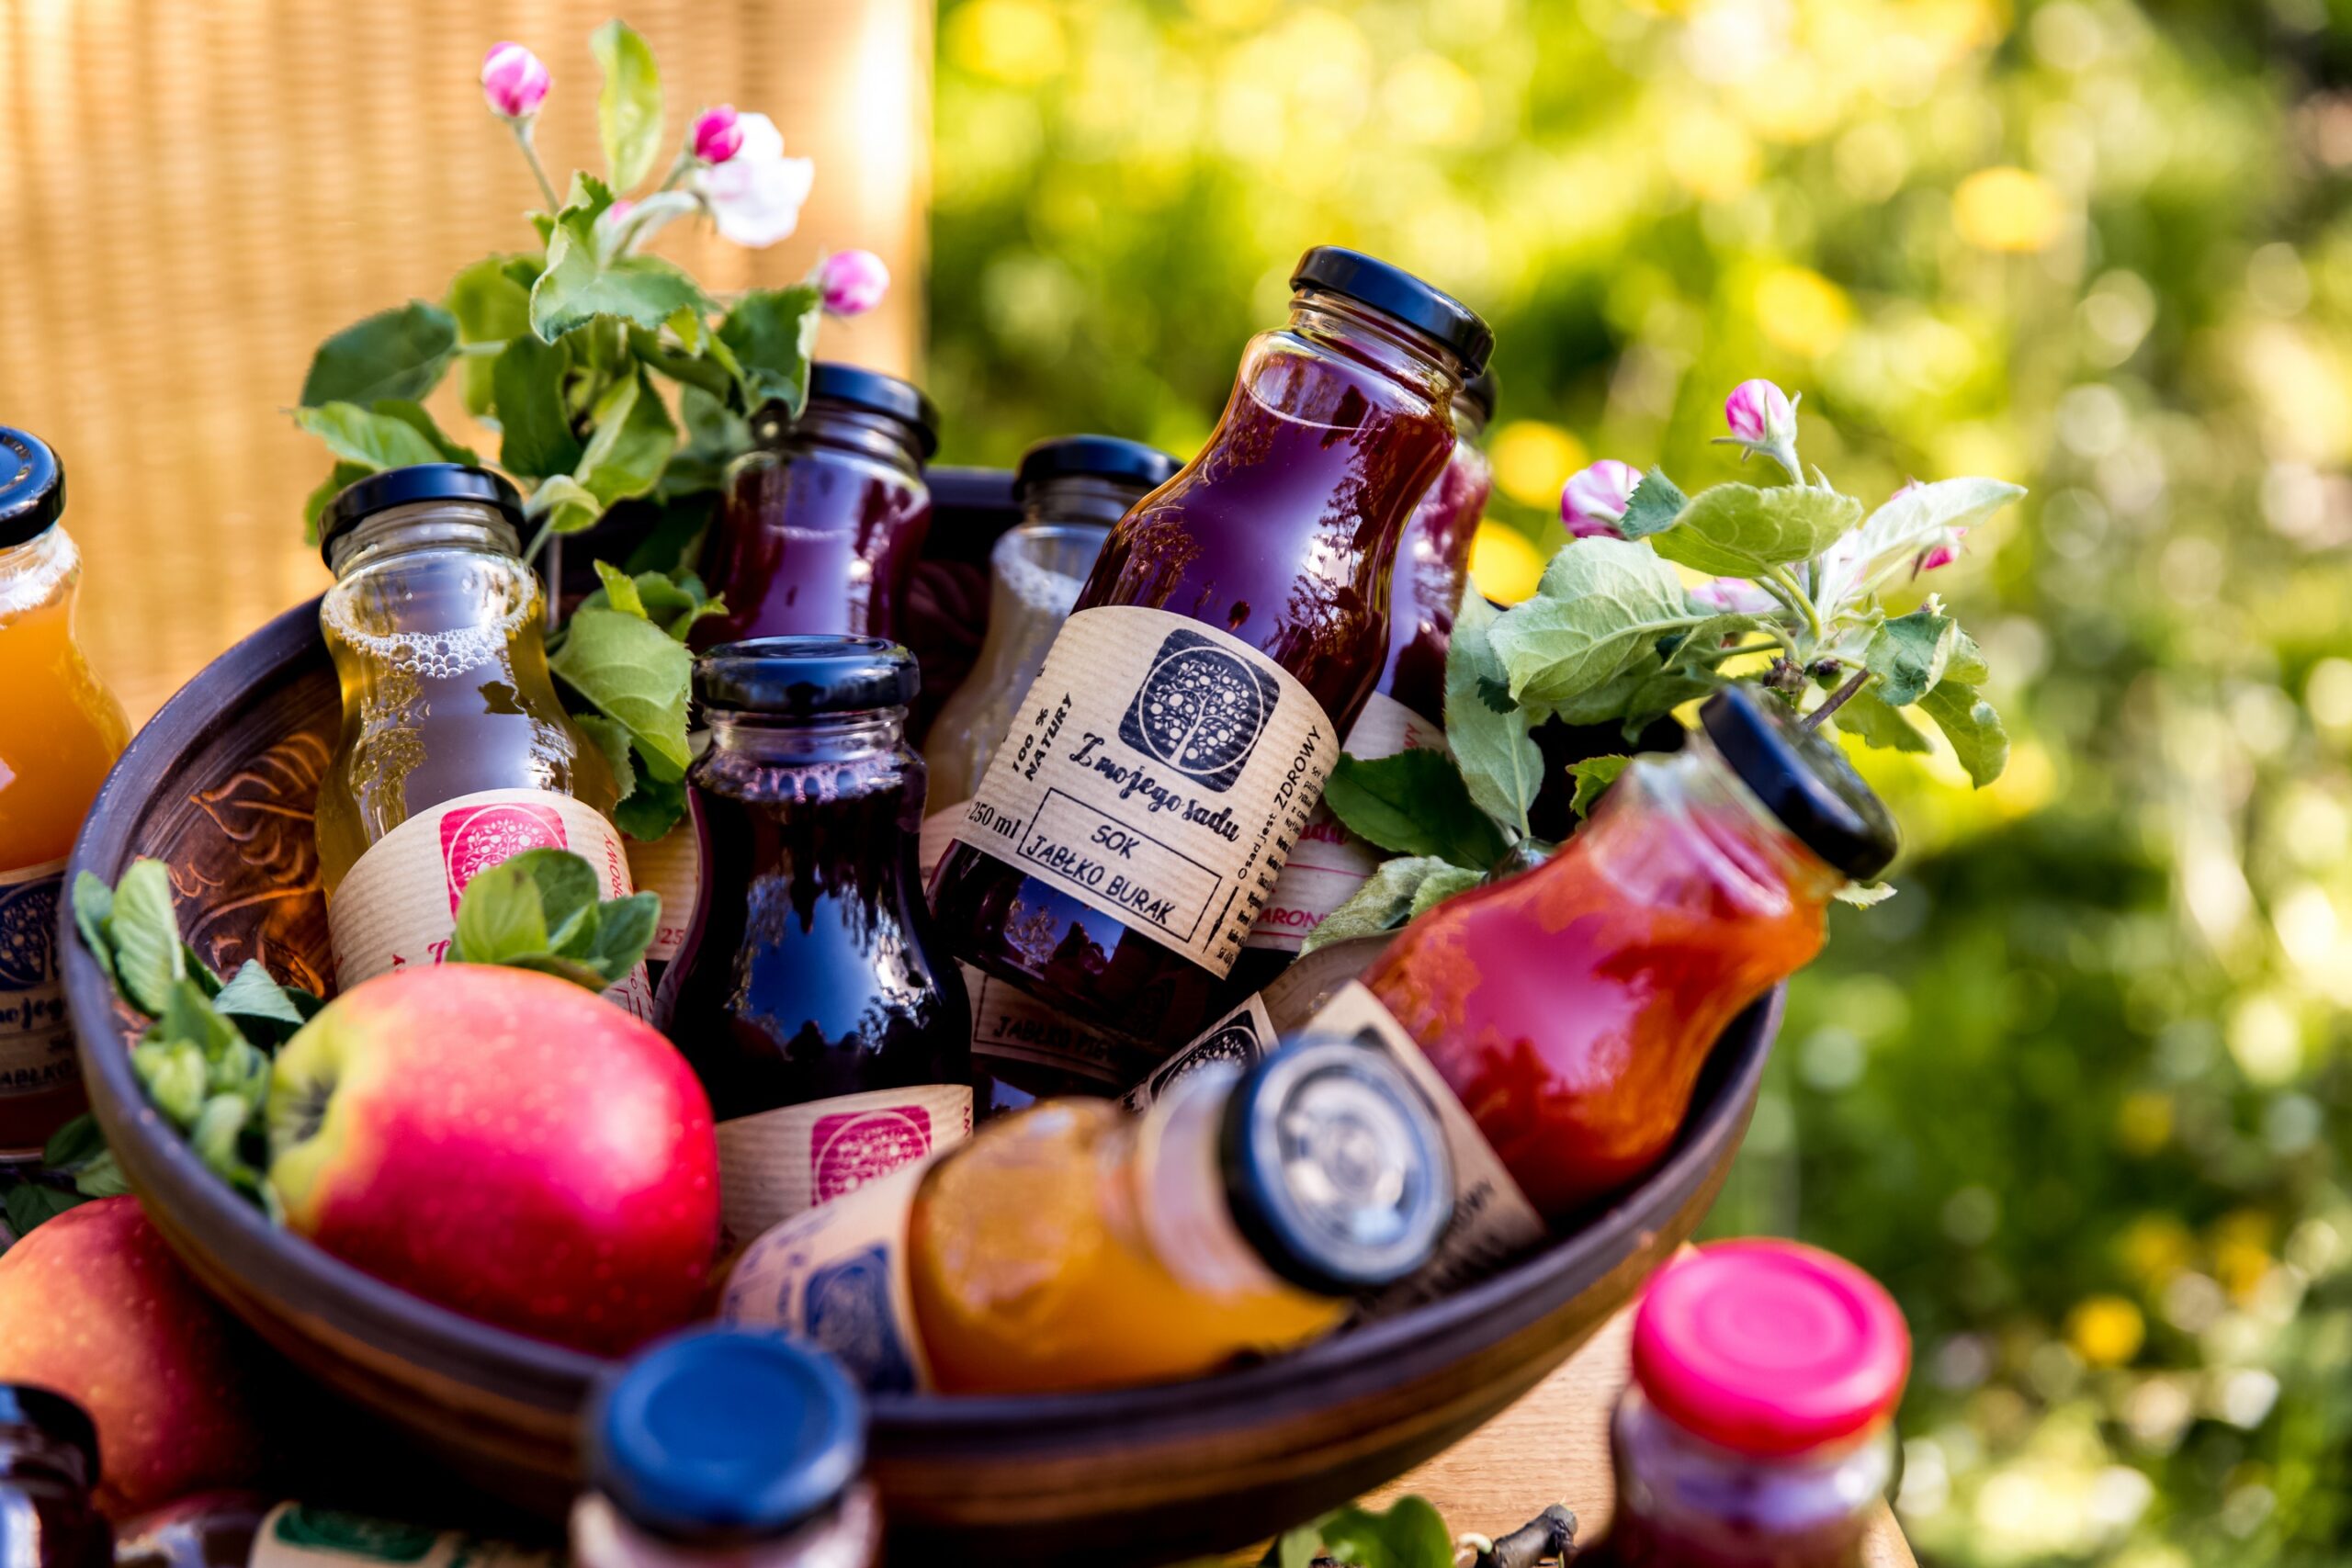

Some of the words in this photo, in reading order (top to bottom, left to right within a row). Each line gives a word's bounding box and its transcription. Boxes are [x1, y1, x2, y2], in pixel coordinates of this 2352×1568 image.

[1012, 734, 1035, 773] 100
[1035, 707, 1049, 727] %
[1023, 692, 1073, 782] NATURY
[967, 801, 995, 827] 250
[992, 812, 1022, 840] ml
[1093, 756, 1182, 813] mojego
[1182, 798, 1240, 842] sadu
[1238, 841, 1261, 880] Osad
[1257, 812, 1278, 844] jest
[1273, 724, 1321, 811] ZDROWY
[1091, 824, 1141, 860] SOK
[1026, 834, 1106, 886] JABŁKO
[1105, 874, 1176, 925] BURAK
[659, 927, 685, 945] 25
[1256, 907, 1328, 928] ARON
